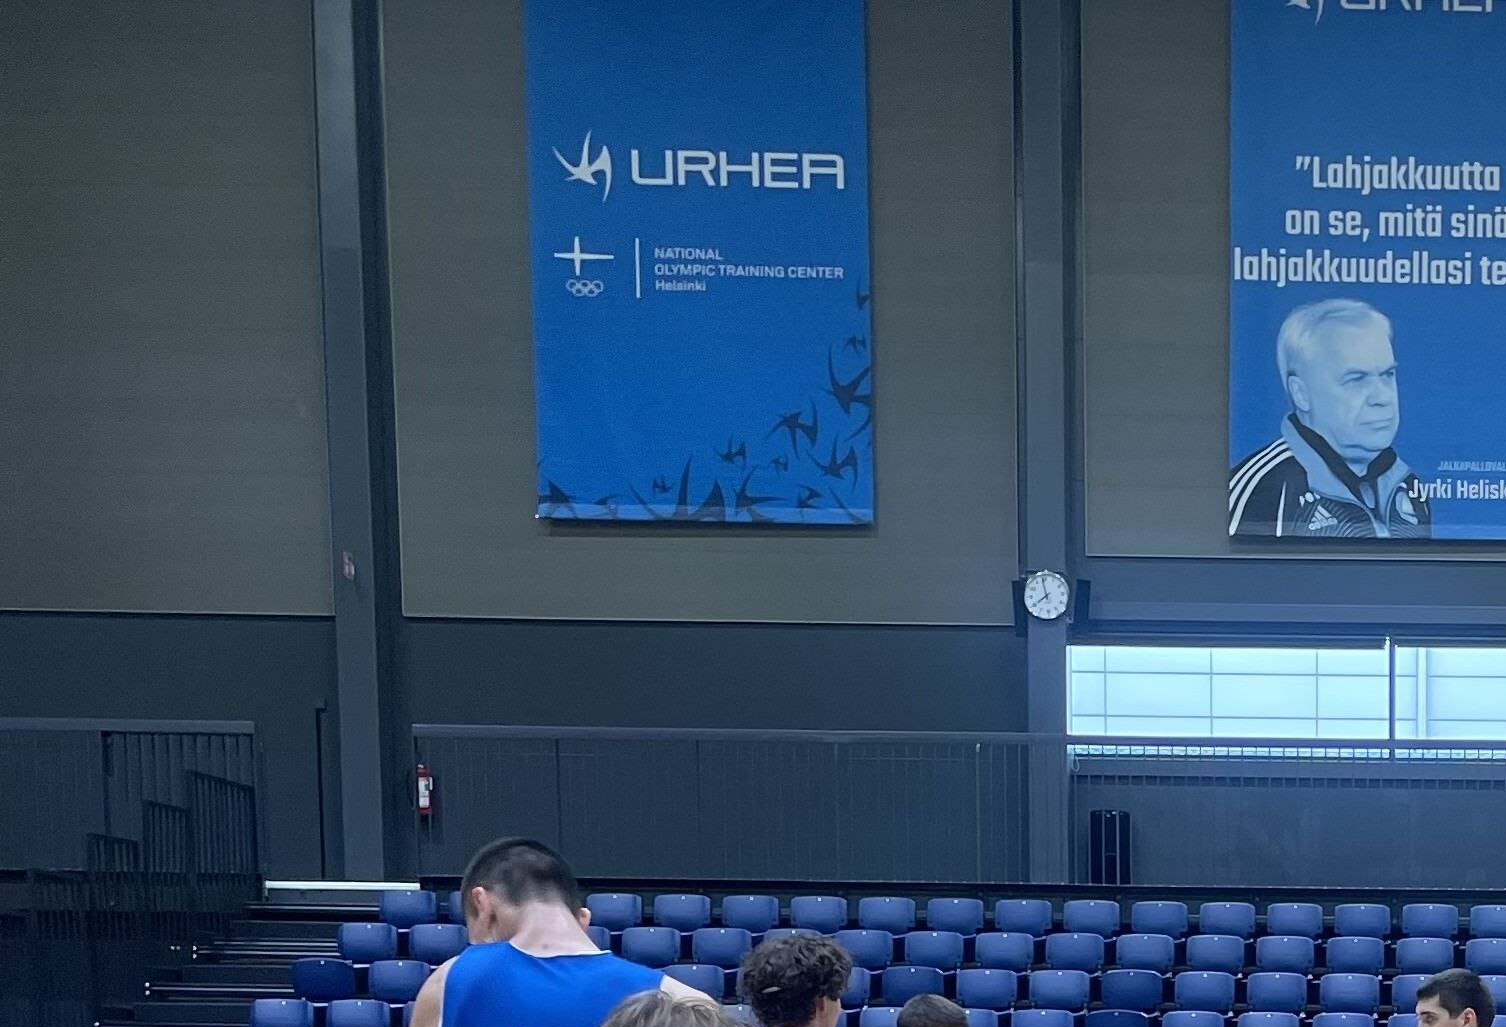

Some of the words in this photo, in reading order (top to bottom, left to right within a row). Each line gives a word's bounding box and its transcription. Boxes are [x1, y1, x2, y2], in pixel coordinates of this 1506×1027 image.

[630, 148, 846, 190] URHEA
[1285, 208, 1320, 235] on
[1328, 209, 1370, 243] se,
[1378, 203, 1442, 237] mitä
[654, 247, 724, 261] NATIONAL
[654, 263, 716, 277] OLYMPIC
[718, 264, 785, 278] TRAINING
[787, 266, 845, 279] CENTER
[1233, 247, 1472, 288] lahjakkuudellasi
[655, 279, 706, 291] Helsinki
[1408, 478, 1451, 502] Jyrki
